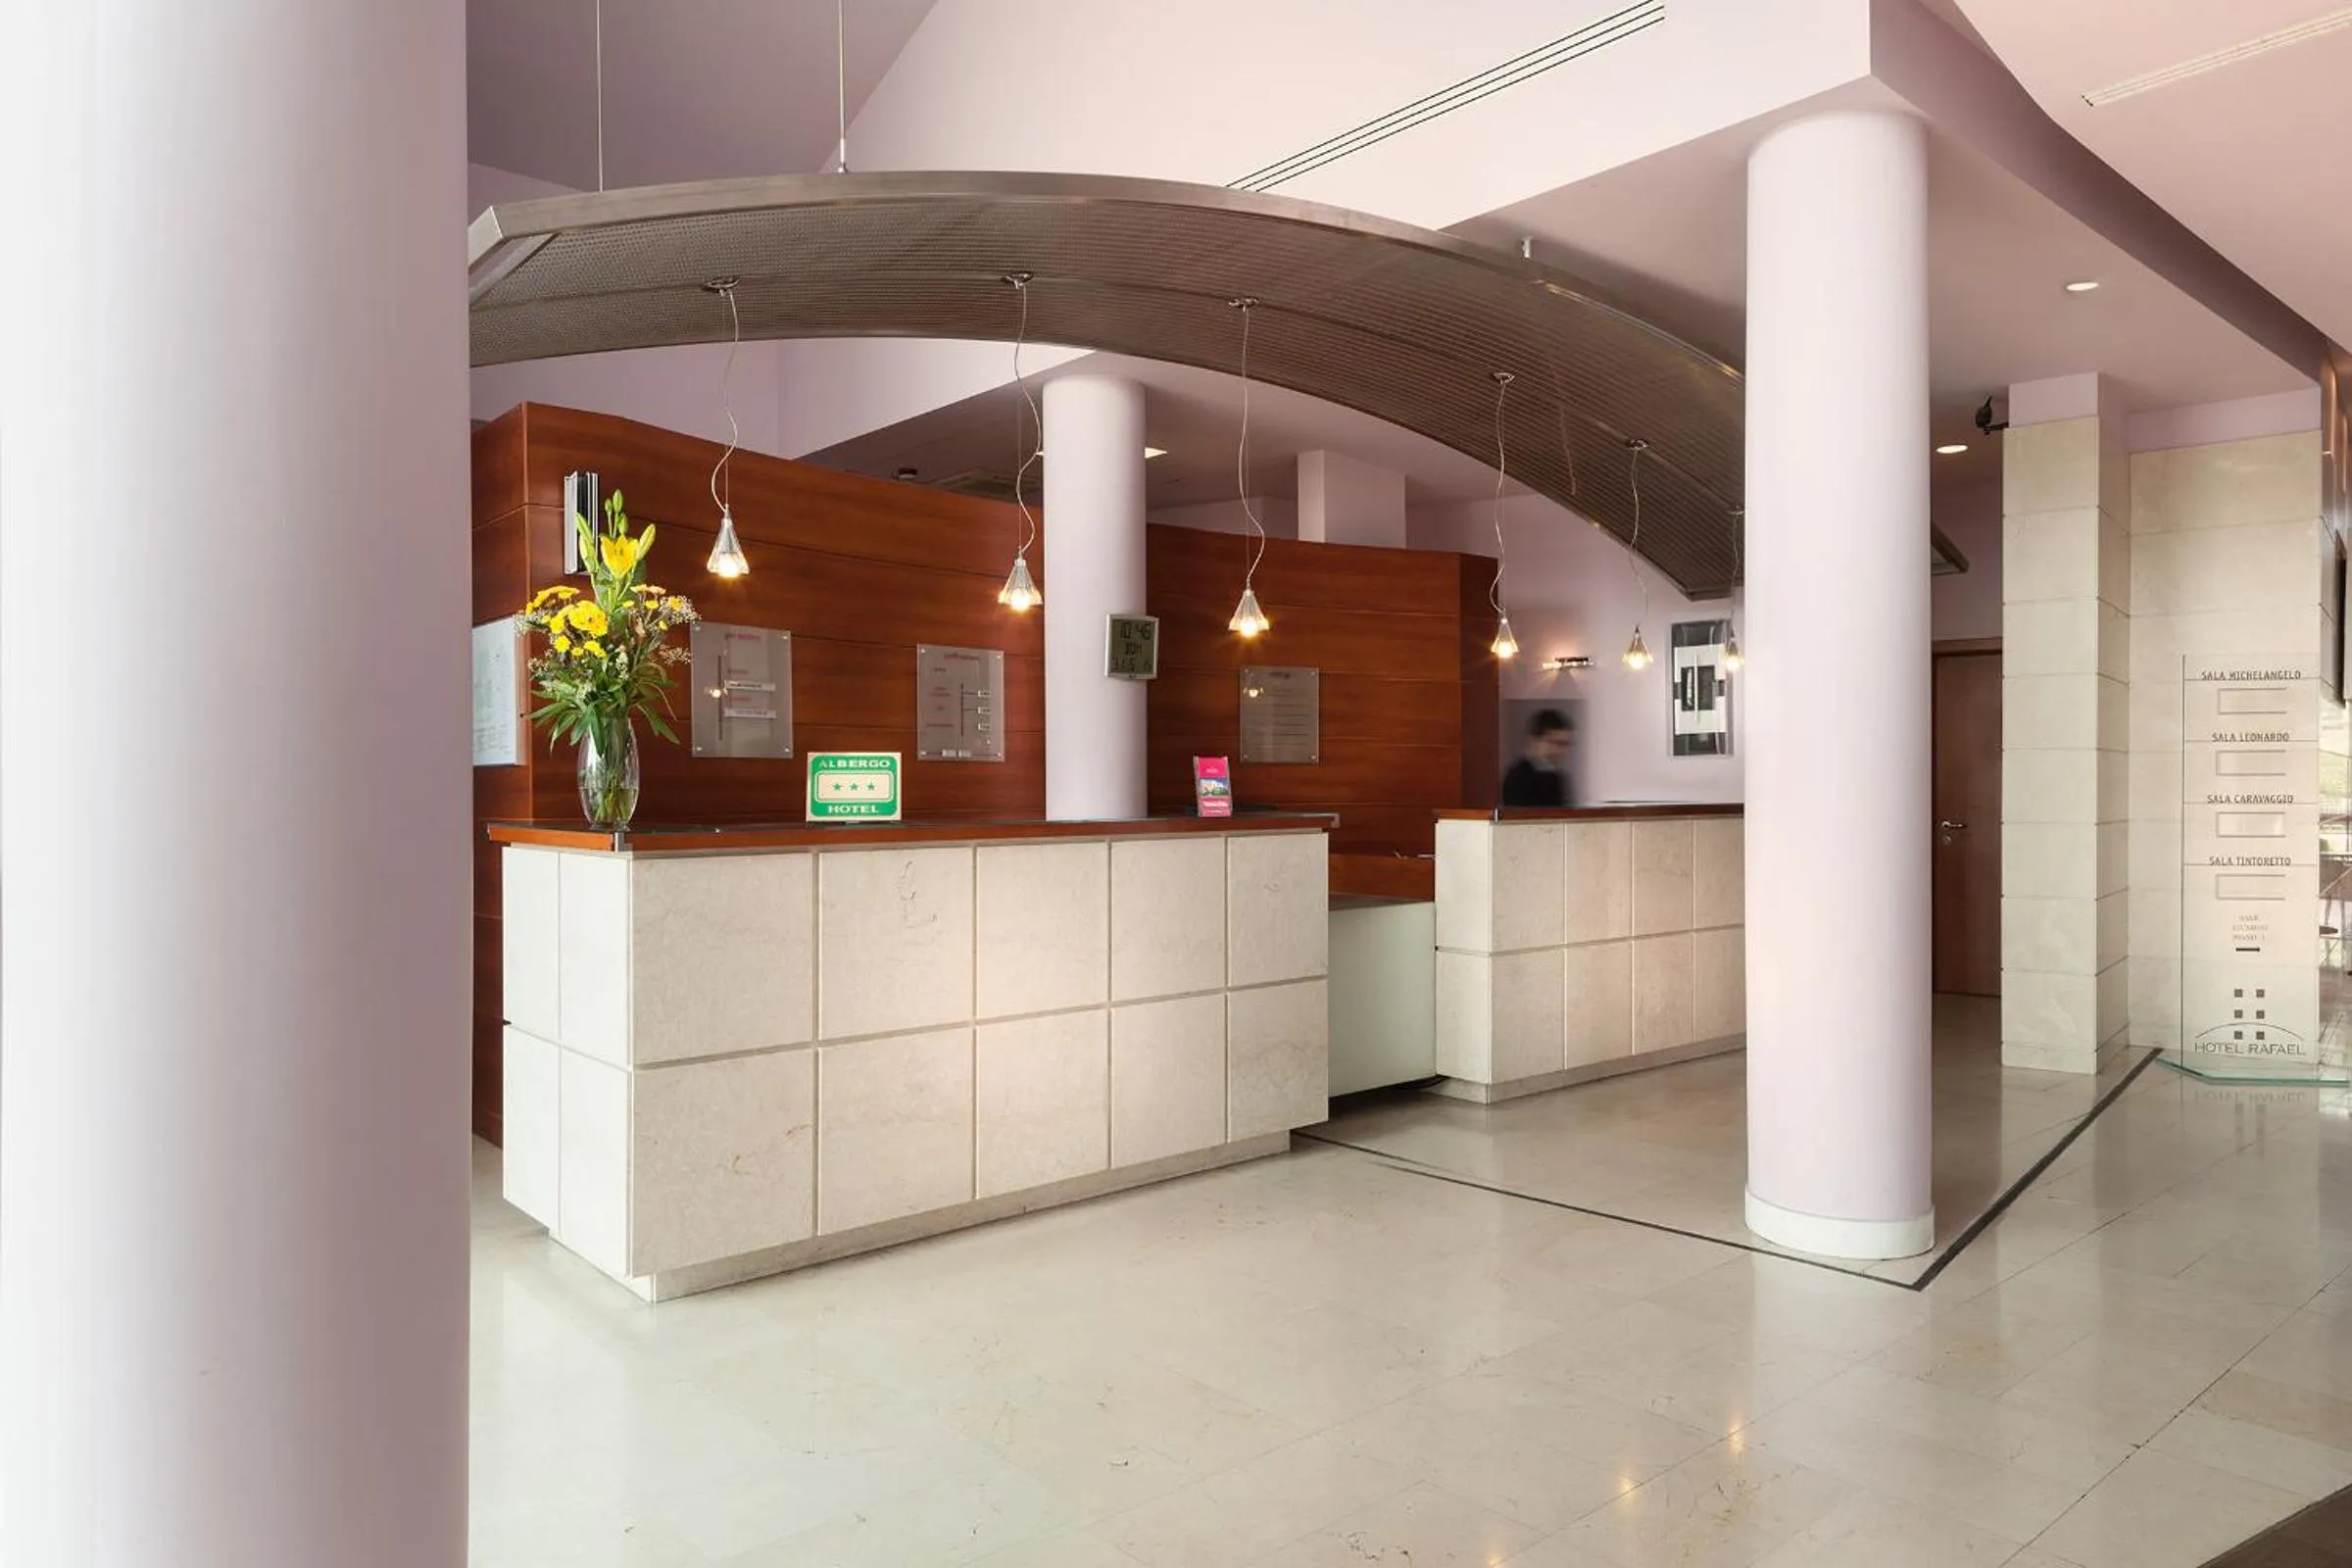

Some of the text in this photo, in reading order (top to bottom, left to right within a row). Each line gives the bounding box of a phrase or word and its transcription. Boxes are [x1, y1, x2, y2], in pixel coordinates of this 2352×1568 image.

[2201, 671, 2301, 681] SALA MICHELANGELO
[2212, 733, 2290, 743] SALA LEONARDO
[818, 760, 891, 768] ALBERGO
[2207, 795, 2294, 805] SALA CARAVAGGIO
[827, 805, 879, 813] HOTEL
[2209, 857, 2291, 866] SALA TINTORETTO
[2194, 1042, 2306, 1055] HOTEL RAFAEL
